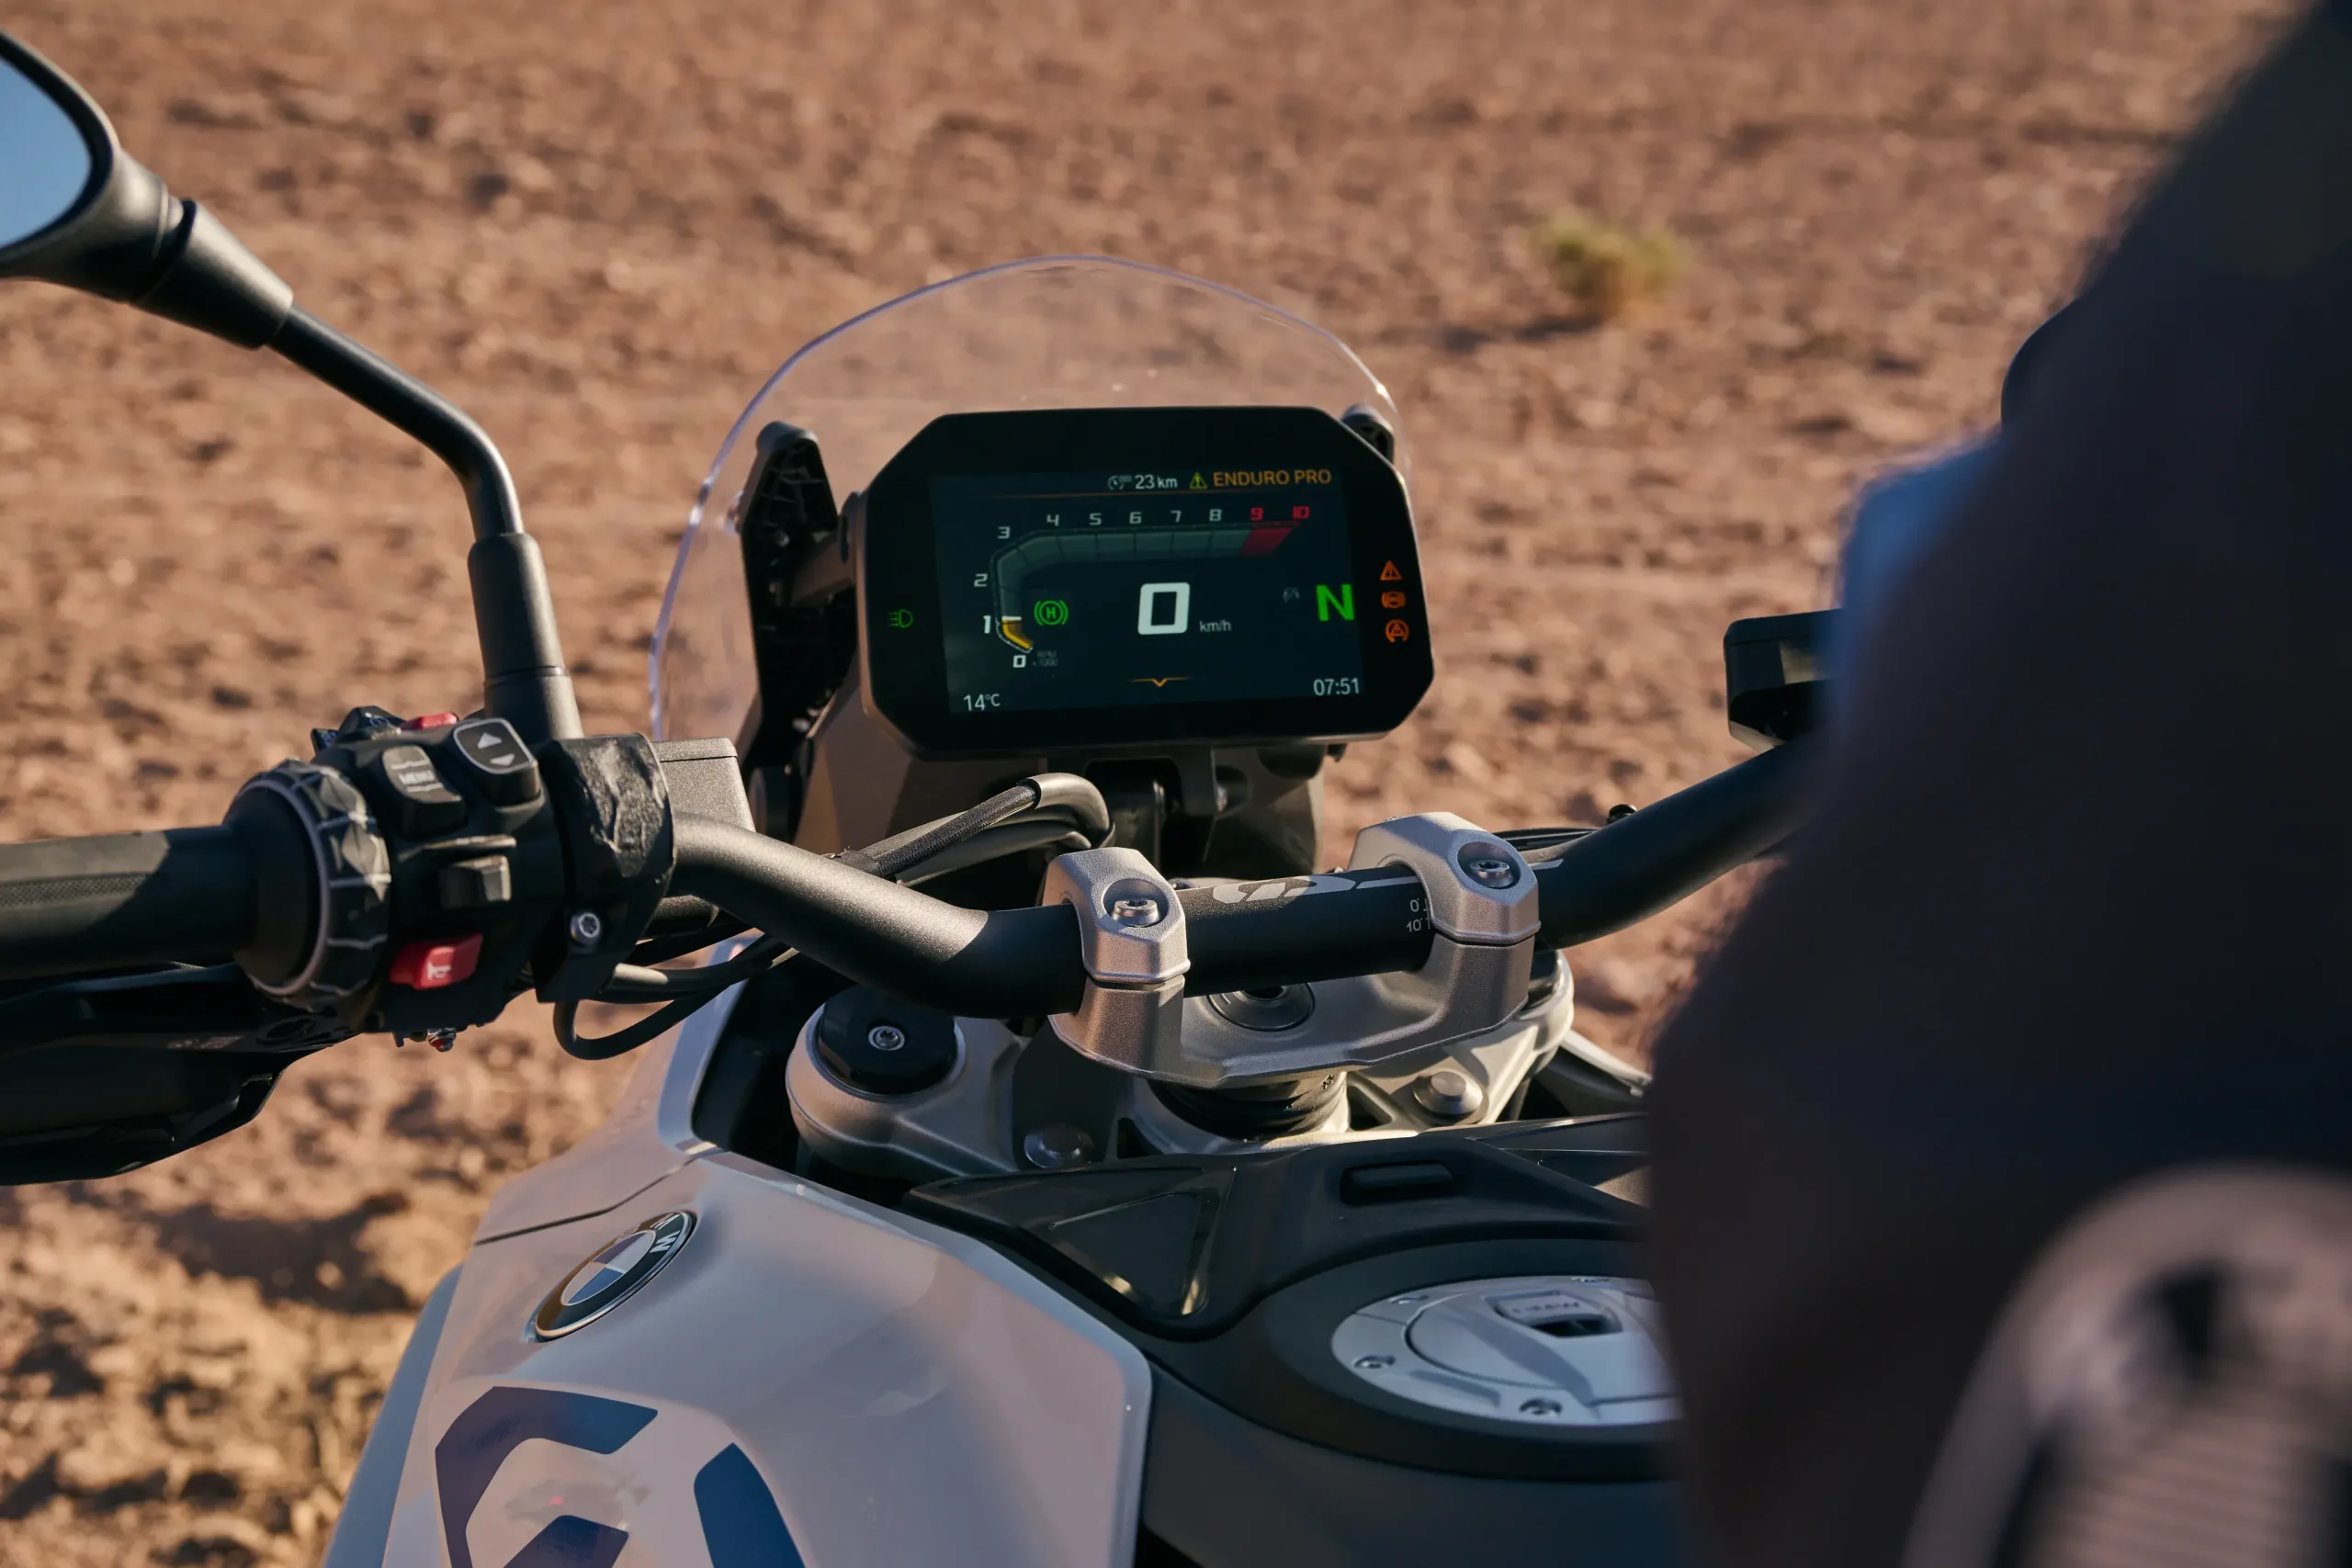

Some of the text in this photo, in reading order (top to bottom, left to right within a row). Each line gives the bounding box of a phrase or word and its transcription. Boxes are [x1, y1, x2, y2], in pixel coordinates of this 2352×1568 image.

[1135, 474, 1178, 490] 23 km
[1213, 468, 1332, 487] ENDURO PRO
[1046, 506, 1310, 526] 4 5 6 7 8 9 10
[997, 526, 1011, 539] 3
[974, 573, 988, 587] 2
[1137, 582, 1232, 635] 0 km/h
[1316, 583, 1355, 622] N
[983, 615, 991, 634] 1
[1012, 654, 1026, 668] 0
[1313, 678, 1360, 696] 07:51
